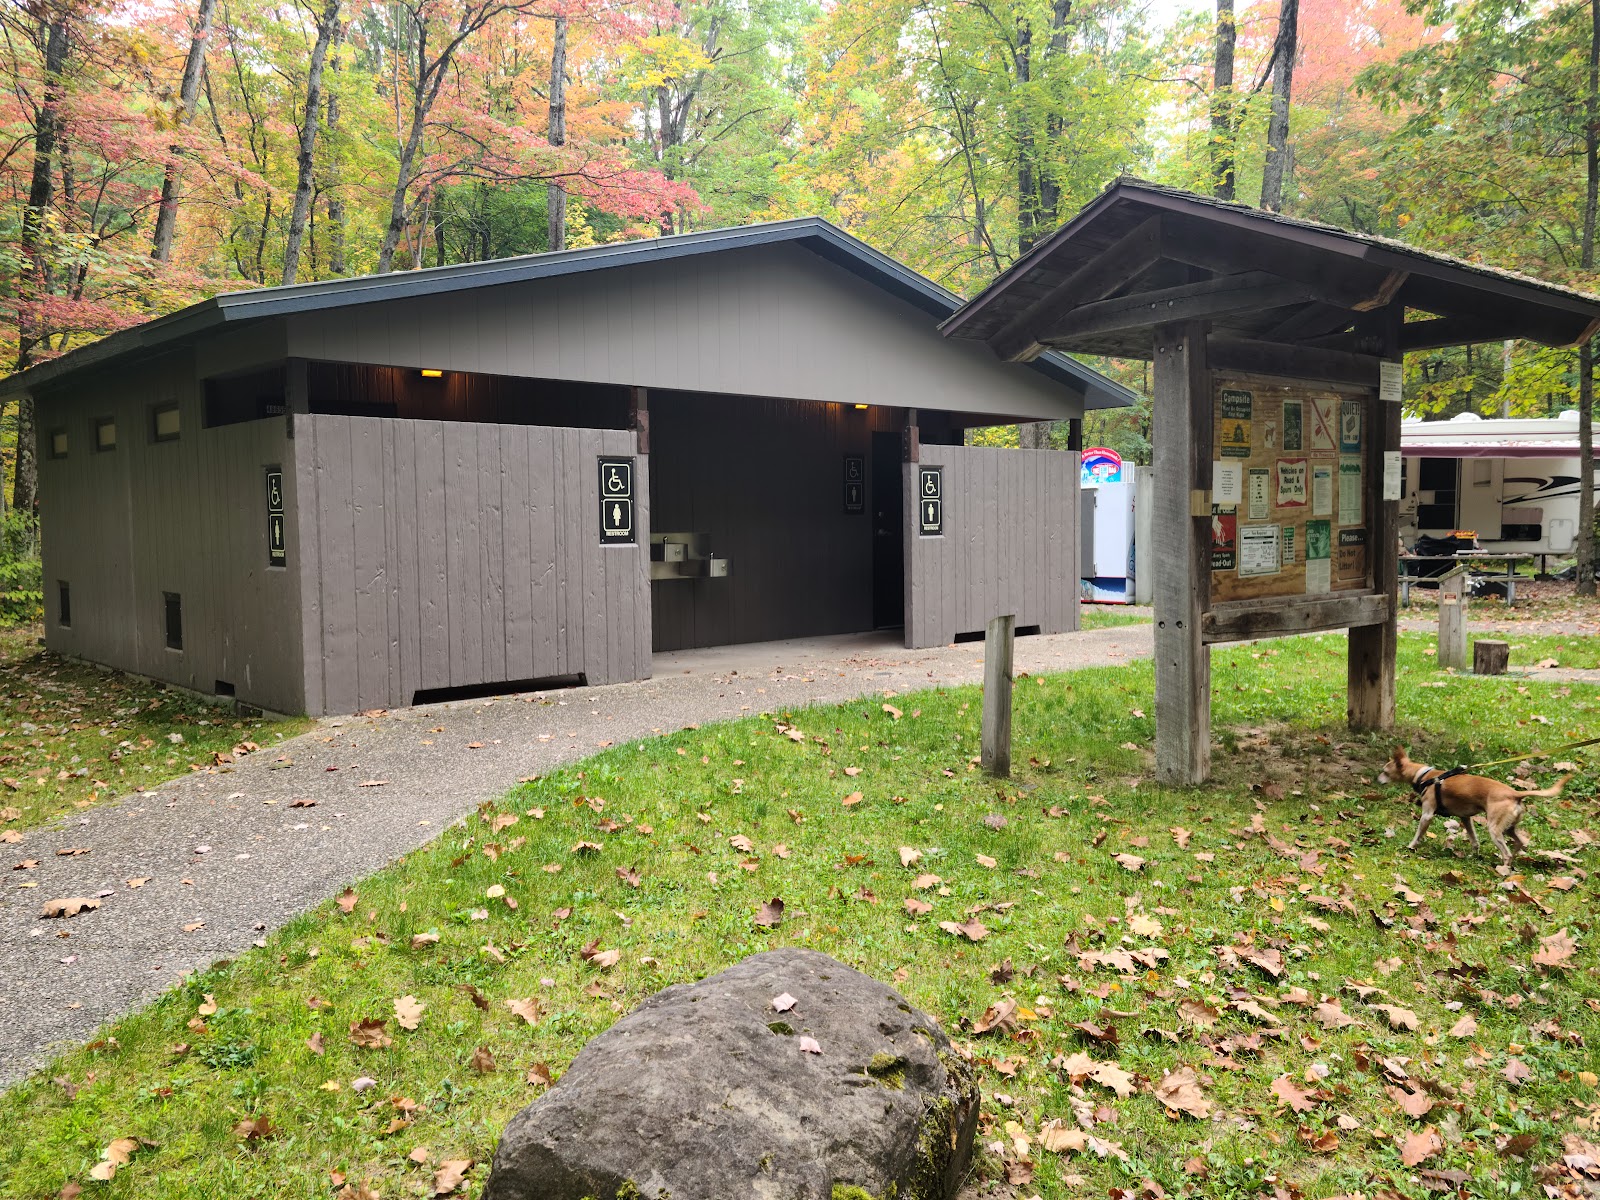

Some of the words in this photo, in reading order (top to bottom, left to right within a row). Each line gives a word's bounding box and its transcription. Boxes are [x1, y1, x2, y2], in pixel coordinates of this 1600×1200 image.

[1223, 392, 1250, 404] Campsite
[1284, 476, 1294, 484] Road
[1294, 485, 1304, 495] Only
[1341, 533, 1363, 542] Please...
